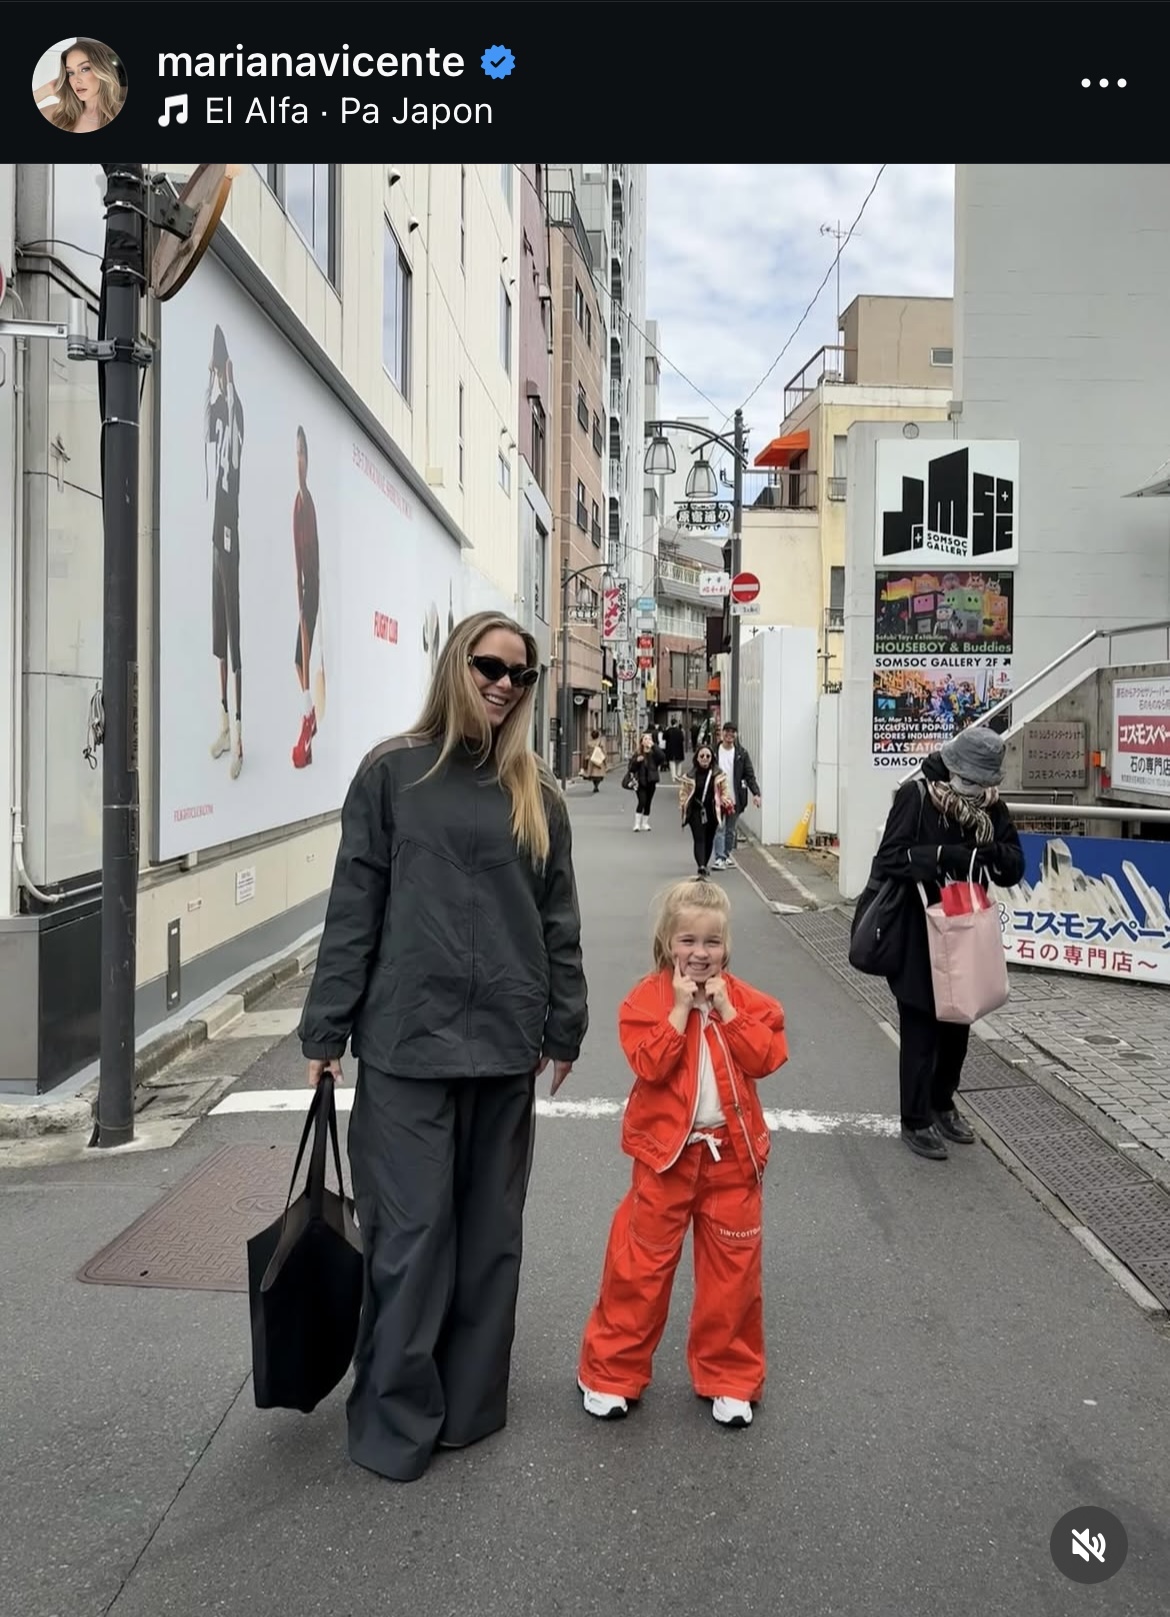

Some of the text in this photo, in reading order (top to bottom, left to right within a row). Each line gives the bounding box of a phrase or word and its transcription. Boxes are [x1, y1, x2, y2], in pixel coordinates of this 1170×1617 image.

[927, 533, 968, 549] SOMSOC
[926, 542, 968, 556] GALLERY
[875, 641, 1012, 653] HOUSEBOY & Buddies
[875, 657, 998, 668] SOMSOC GALLERY 2F
[873, 723, 955, 732] EXCLUSIVE POP-UP
[907, 732, 954, 740] INDUSTRIES
[1013, 909, 1170, 950] コスモスペー
